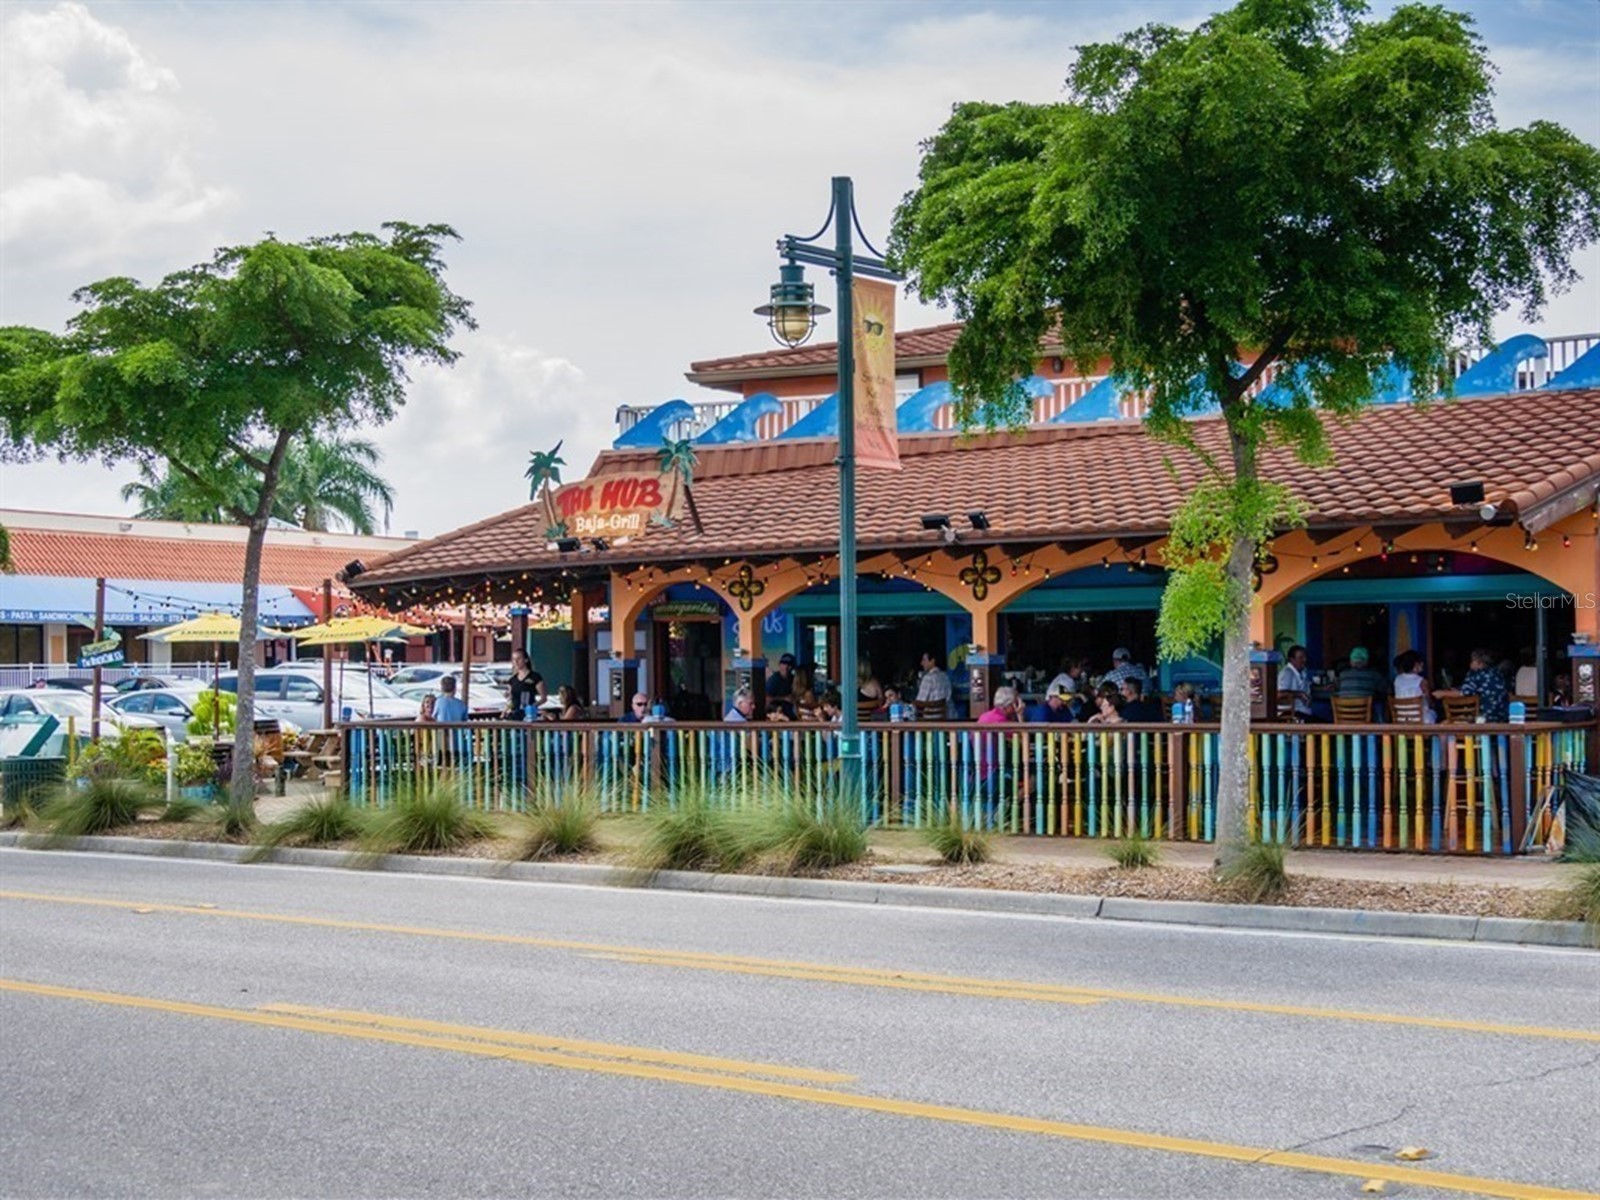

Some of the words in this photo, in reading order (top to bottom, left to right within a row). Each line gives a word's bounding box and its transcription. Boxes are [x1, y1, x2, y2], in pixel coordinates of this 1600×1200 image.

[556, 485, 593, 517] THE
[600, 477, 663, 510] HUB
[576, 513, 640, 533] Baja-Grill
[11, 612, 33, 620] PASTA
[139, 613, 165, 622] SALADS
